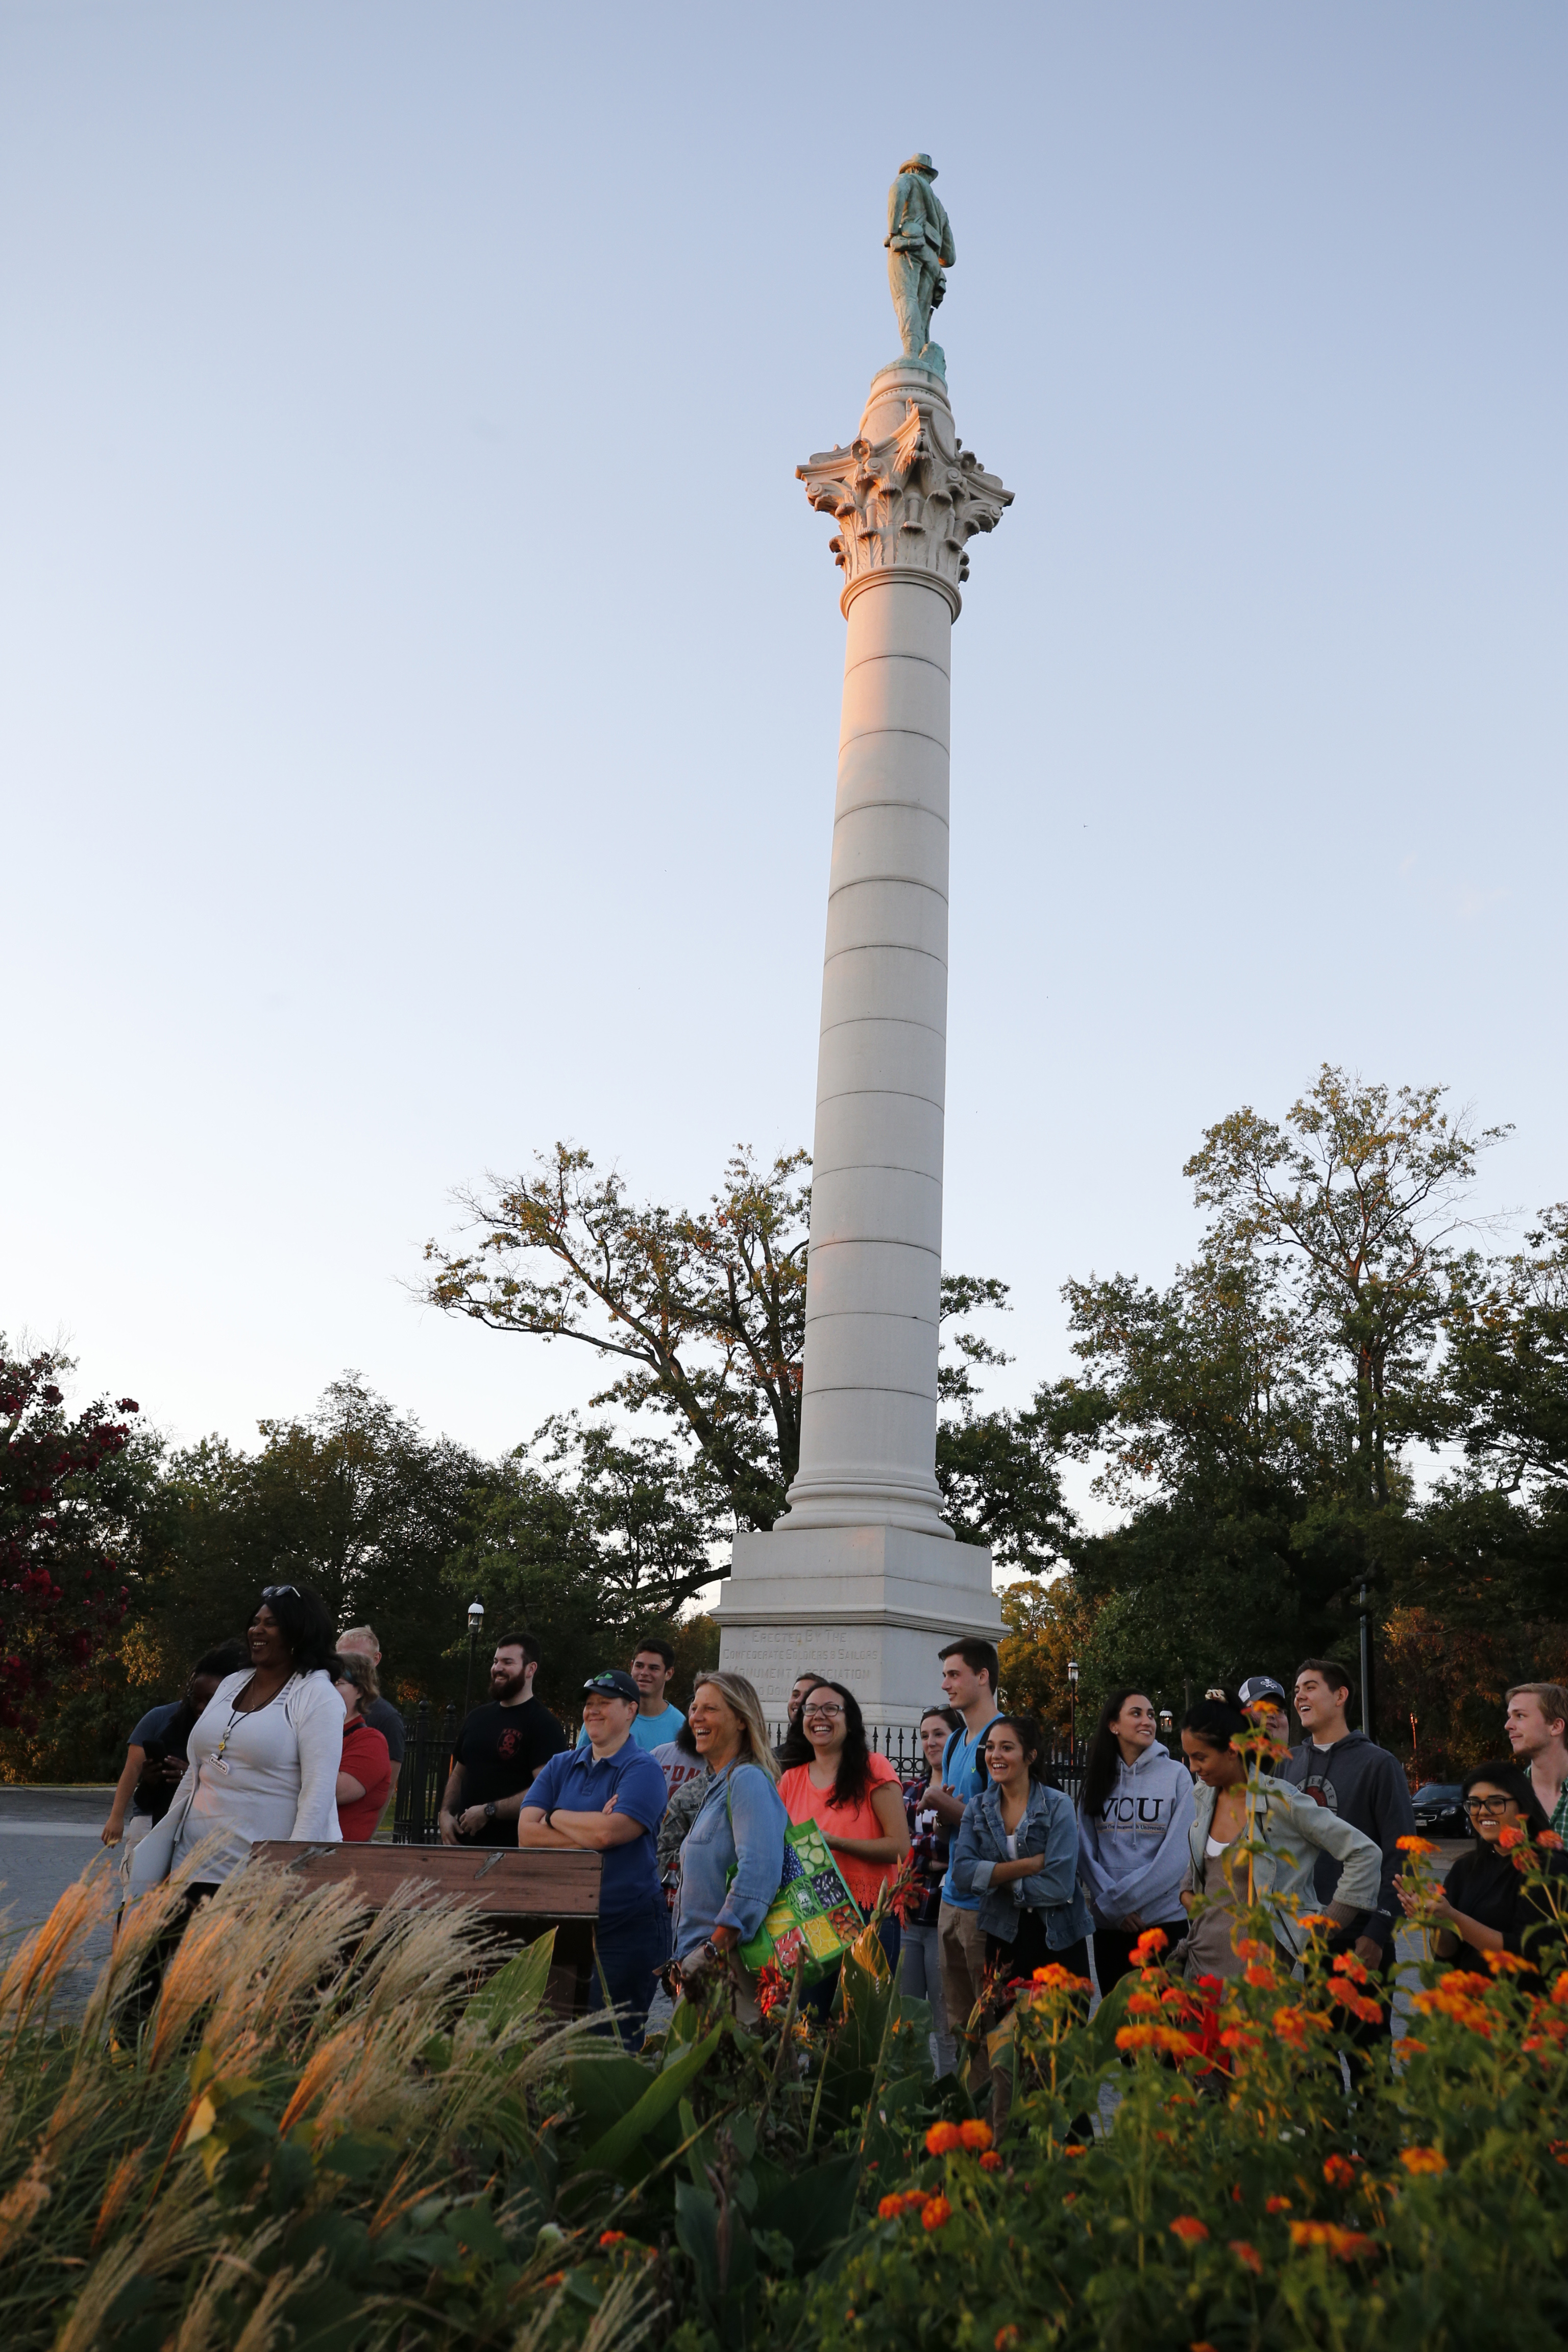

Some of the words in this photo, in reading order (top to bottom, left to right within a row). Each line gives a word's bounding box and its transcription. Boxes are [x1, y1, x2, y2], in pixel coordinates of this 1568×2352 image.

[753, 1630, 802, 1643] ERECTED
[806, 1629, 821, 1642] BY
[825, 1629, 847, 1643] THE
[723, 1649, 784, 1659] CONFEDERATE
[787, 1649, 827, 1660] SOLDIERS
[838, 1649, 877, 1660] SAILORS
[767, 1685, 791, 1696] DOMI
[662, 1765, 701, 1782] FDN
[1101, 1797, 1164, 1822] VCU
